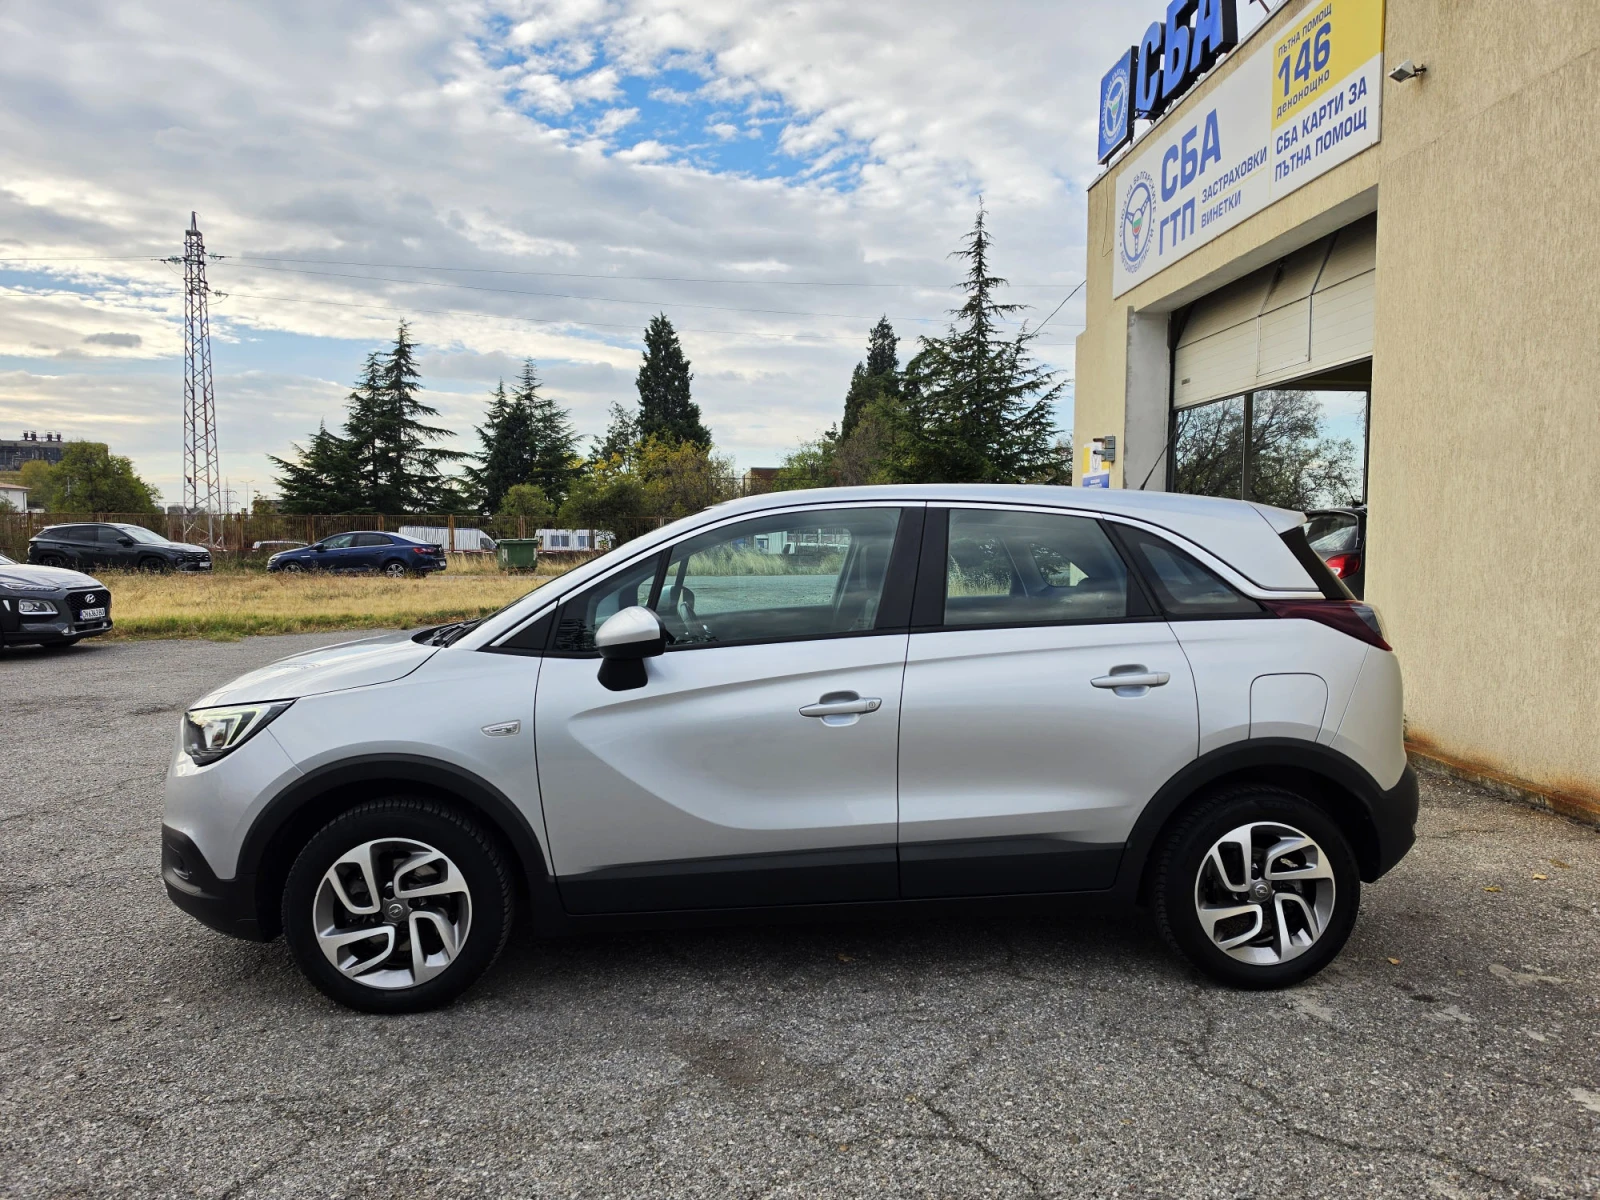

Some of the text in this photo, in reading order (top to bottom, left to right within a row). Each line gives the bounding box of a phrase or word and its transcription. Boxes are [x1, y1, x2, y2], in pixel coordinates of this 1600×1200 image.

[1135, 0, 1224, 119] СБА
[1277, 22, 1332, 97] 146
[1278, 3, 1332, 57] ПЪТНА ПОМОЩ
[1276, 69, 1330, 120] денонощно
[1276, 76, 1367, 155] СБА КАРТИ ЗА
[1161, 108, 1221, 203] СБА
[1202, 146, 1267, 204] ЗАСТРАХОВКИ
[1275, 106, 1367, 182] ПЪТНА ПОМОЩ
[1159, 196, 1196, 256] ГТП
[1201, 190, 1241, 229] ВИНЕТКИ
